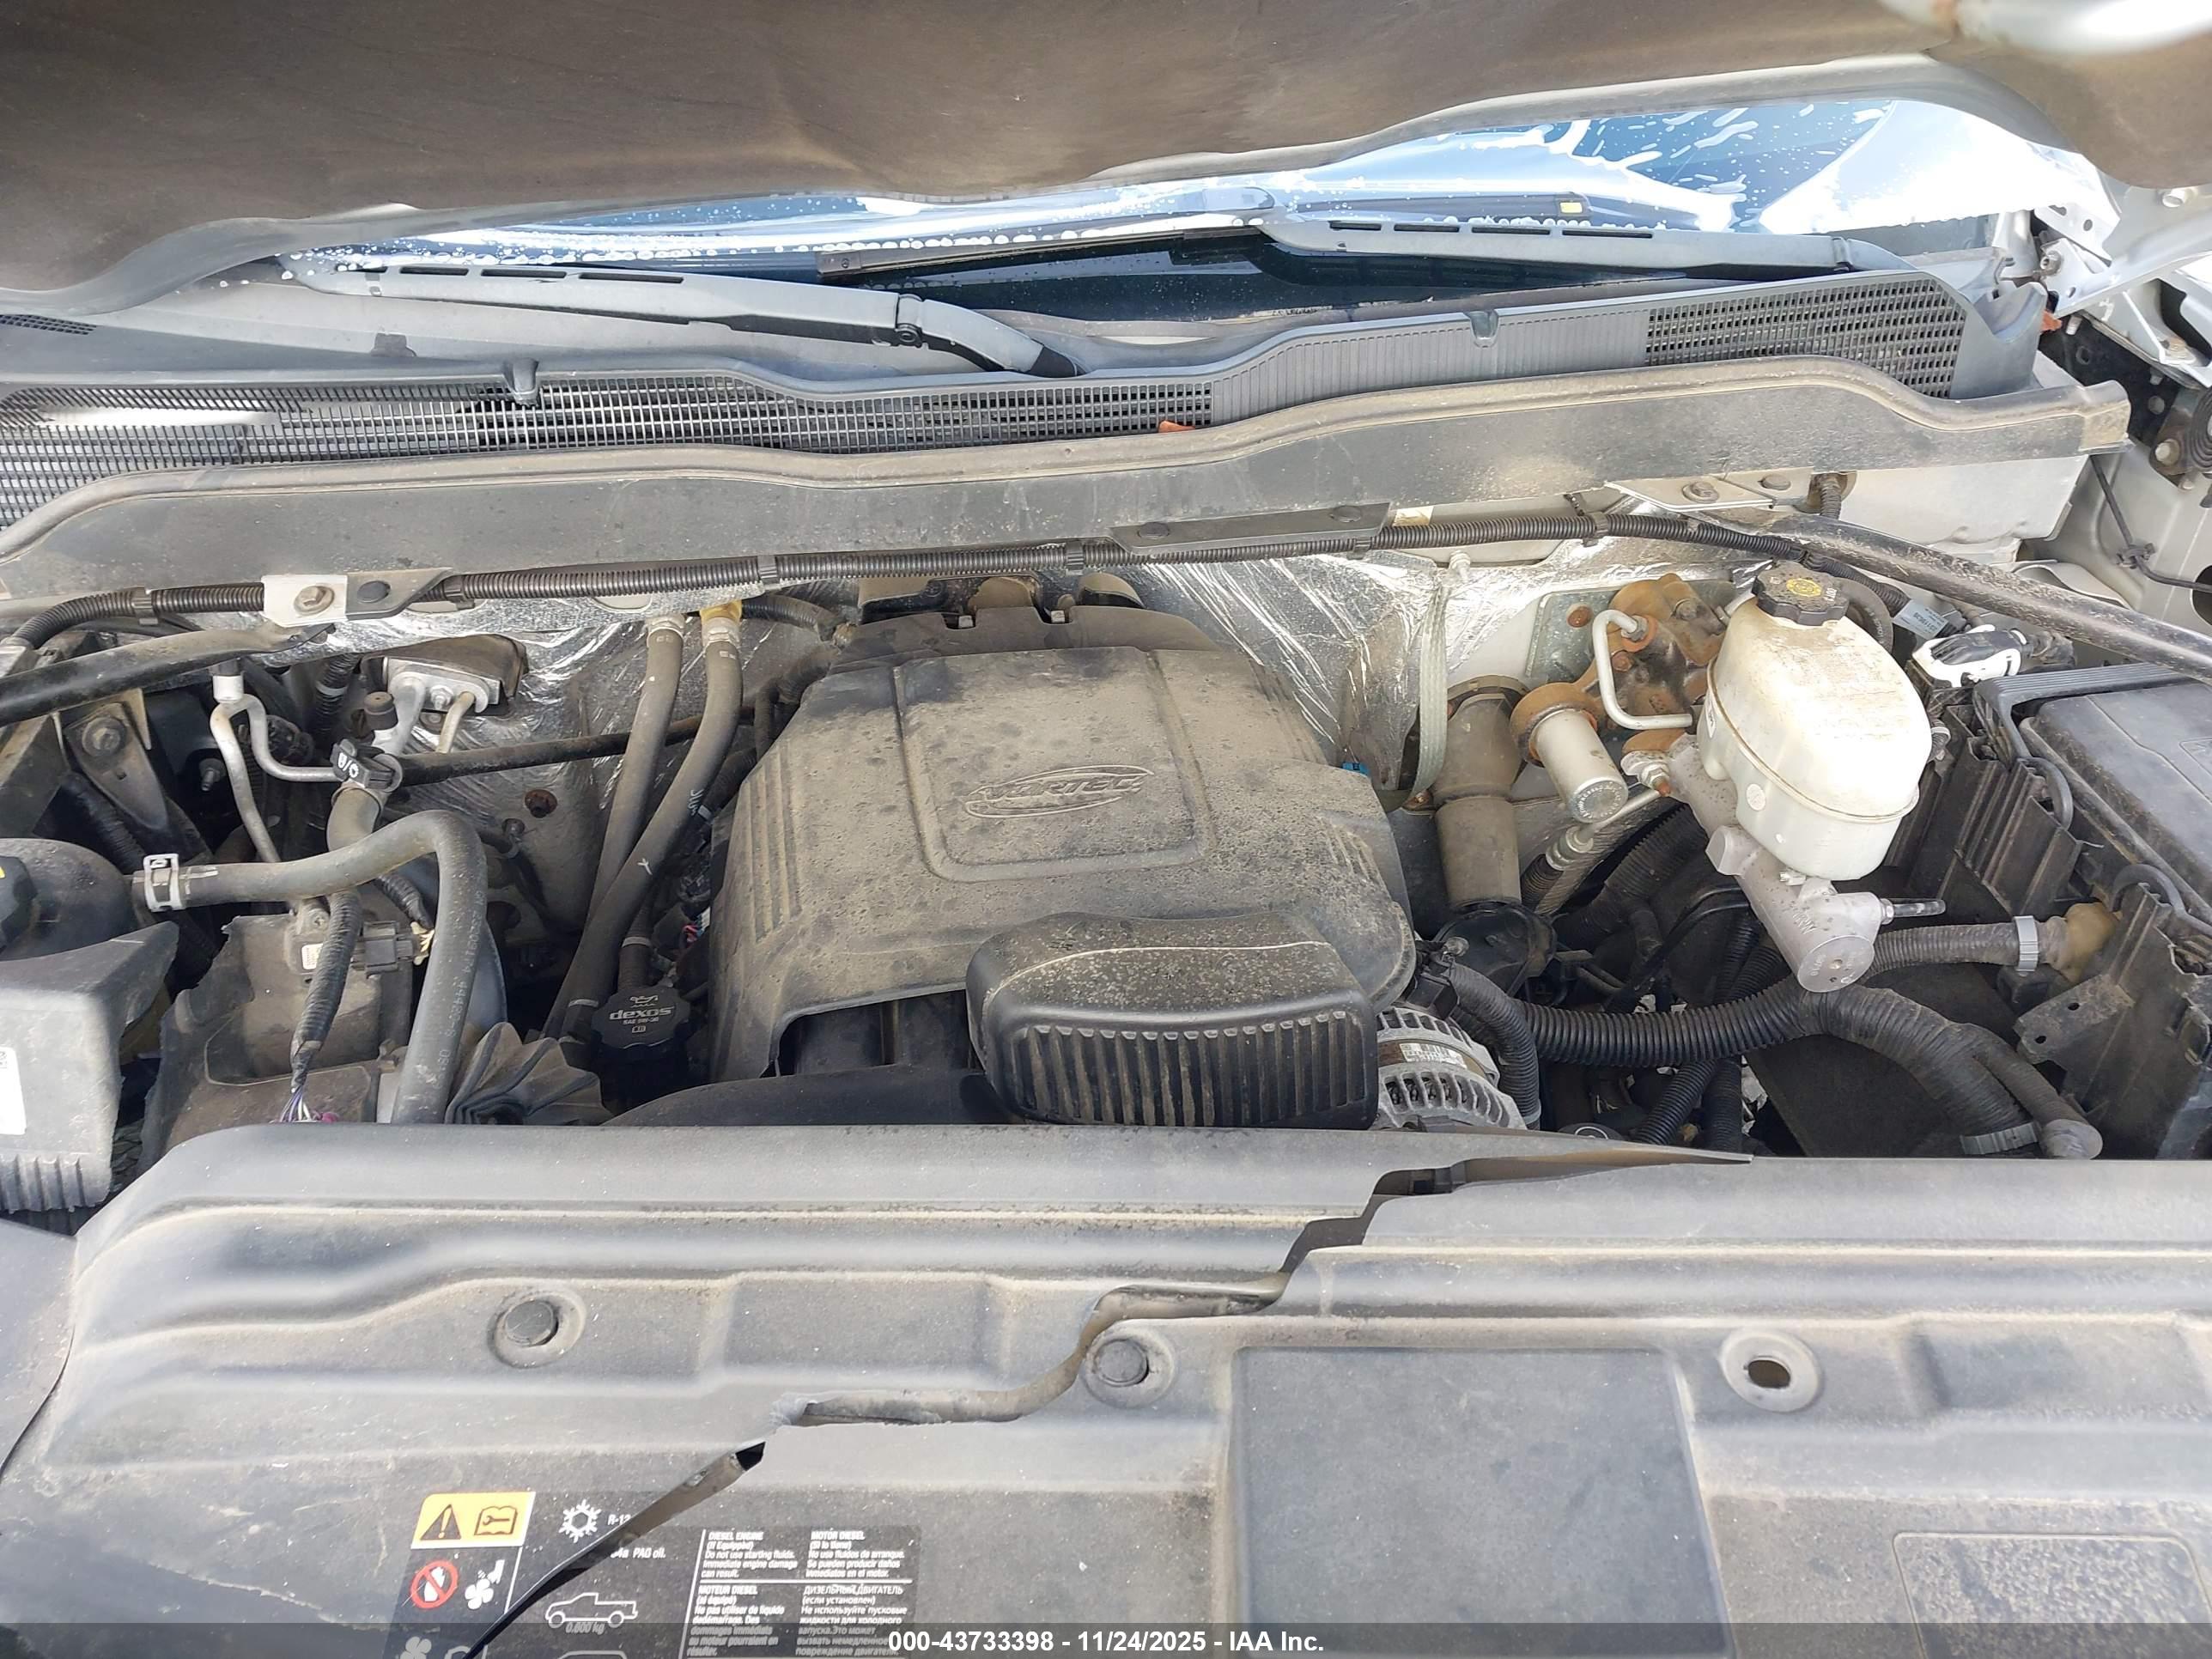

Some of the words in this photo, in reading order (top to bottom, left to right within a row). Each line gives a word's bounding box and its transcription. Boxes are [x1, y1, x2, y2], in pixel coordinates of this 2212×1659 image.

[609, 1006, 675, 1020] dexos
[708, 1531, 734, 1540] DIESEL
[736, 1531, 764, 1540] ENGINE
[839, 1531, 866, 1540] DIESEL
[744, 1550, 772, 1560] starting
[773, 1549, 795, 1559] fluids.
[808, 1550, 819, 1559] No
[820, 1550, 834, 1559] use
[835, 1550, 860, 1559] fluidos
[860, 1550, 870, 1559] de
[871, 1550, 905, 1559] arranque.
[743, 1559, 768, 1570] engine
[768, 1559, 798, 1570] damage
[807, 1559, 817, 1568] Se
[817, 1559, 846, 1569] pueden
[846, 1559, 877, 1569] producir
[847, 1569, 857, 1577] en
[698, 1584, 731, 1595] MOTEUR
[732, 1585, 758, 1595] DIESEL
[857, 1584, 903, 1595] ДВИГАТЕЛЬ
[802, 1595, 824, 1605] (если
[825, 1595, 875, 1605] установлен)
[748, 1606, 759, 1614] de
[801, 1606, 812, 1614] Не
[842, 1616, 856, 1626] для
